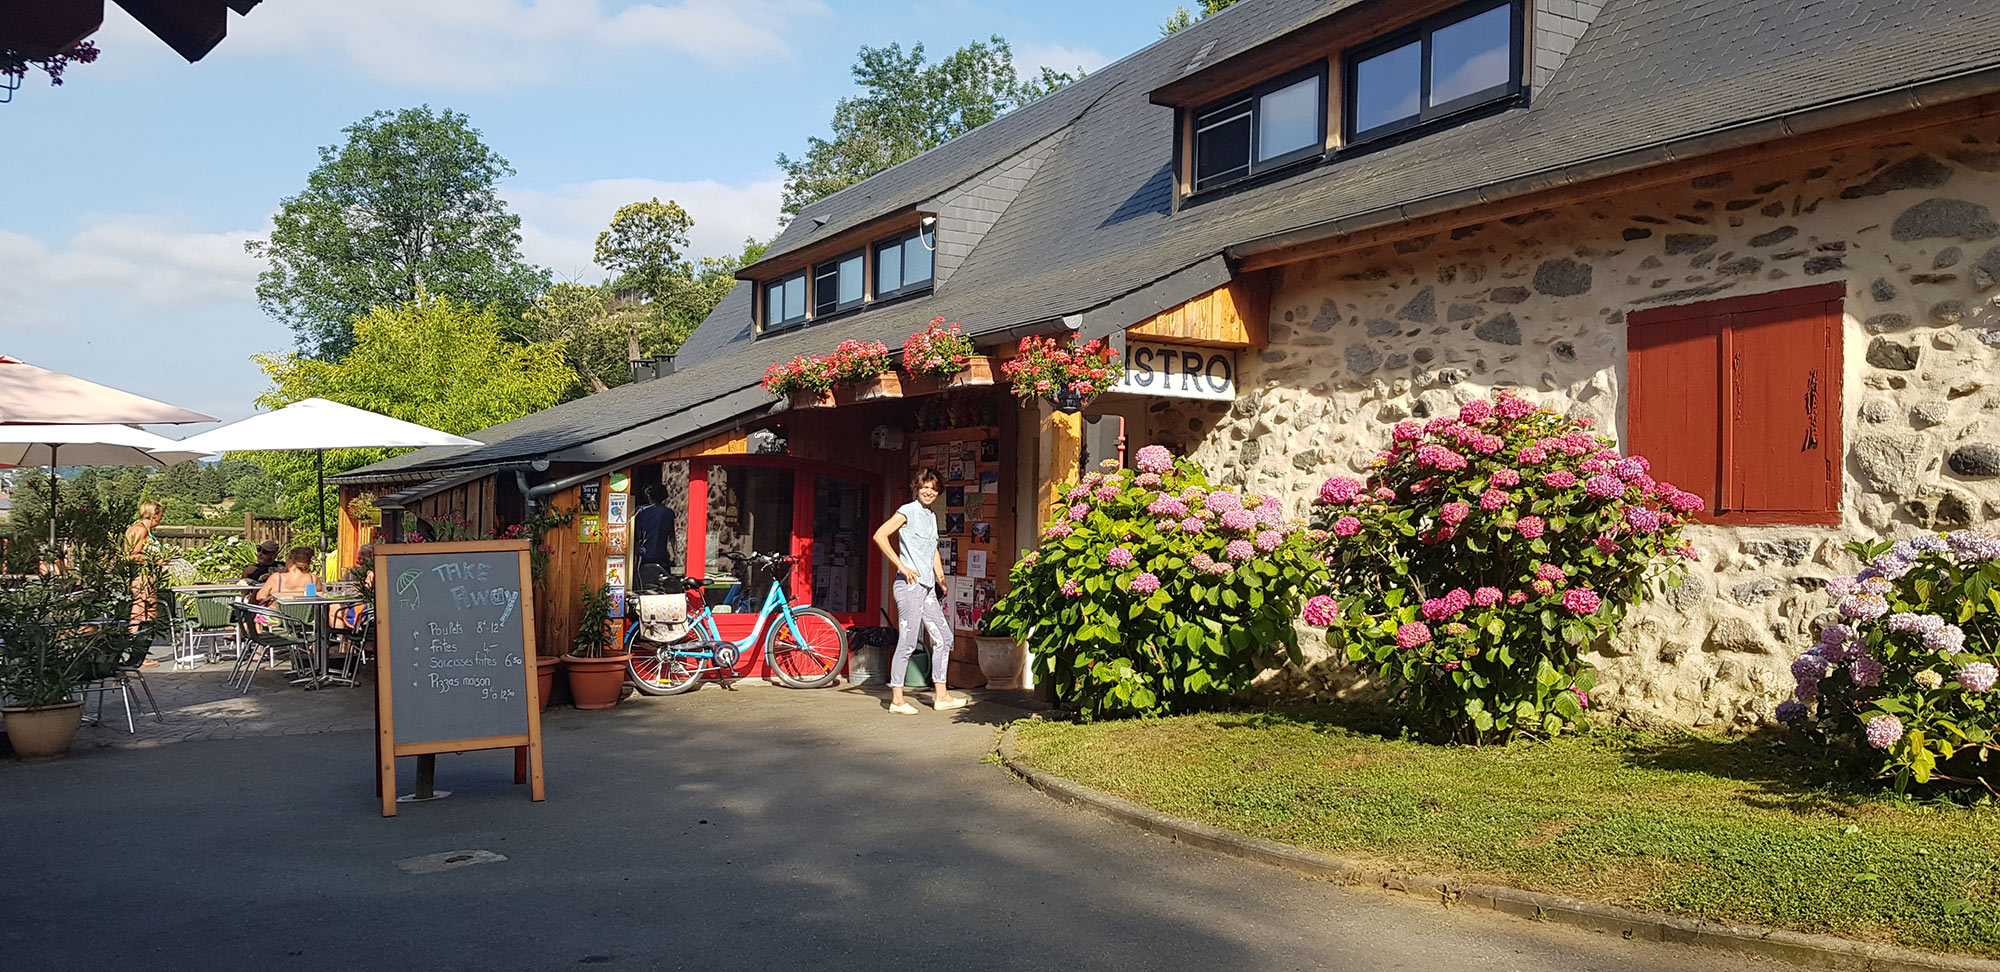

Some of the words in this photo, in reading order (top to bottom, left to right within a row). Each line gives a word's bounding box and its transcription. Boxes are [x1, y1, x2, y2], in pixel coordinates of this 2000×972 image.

[1122, 345, 1232, 394] ISTRO
[432, 562, 489, 582] TAKE
[428, 621, 463, 636] Poulets
[428, 673, 460, 694] Pizzas
[462, 675, 491, 687] maison
